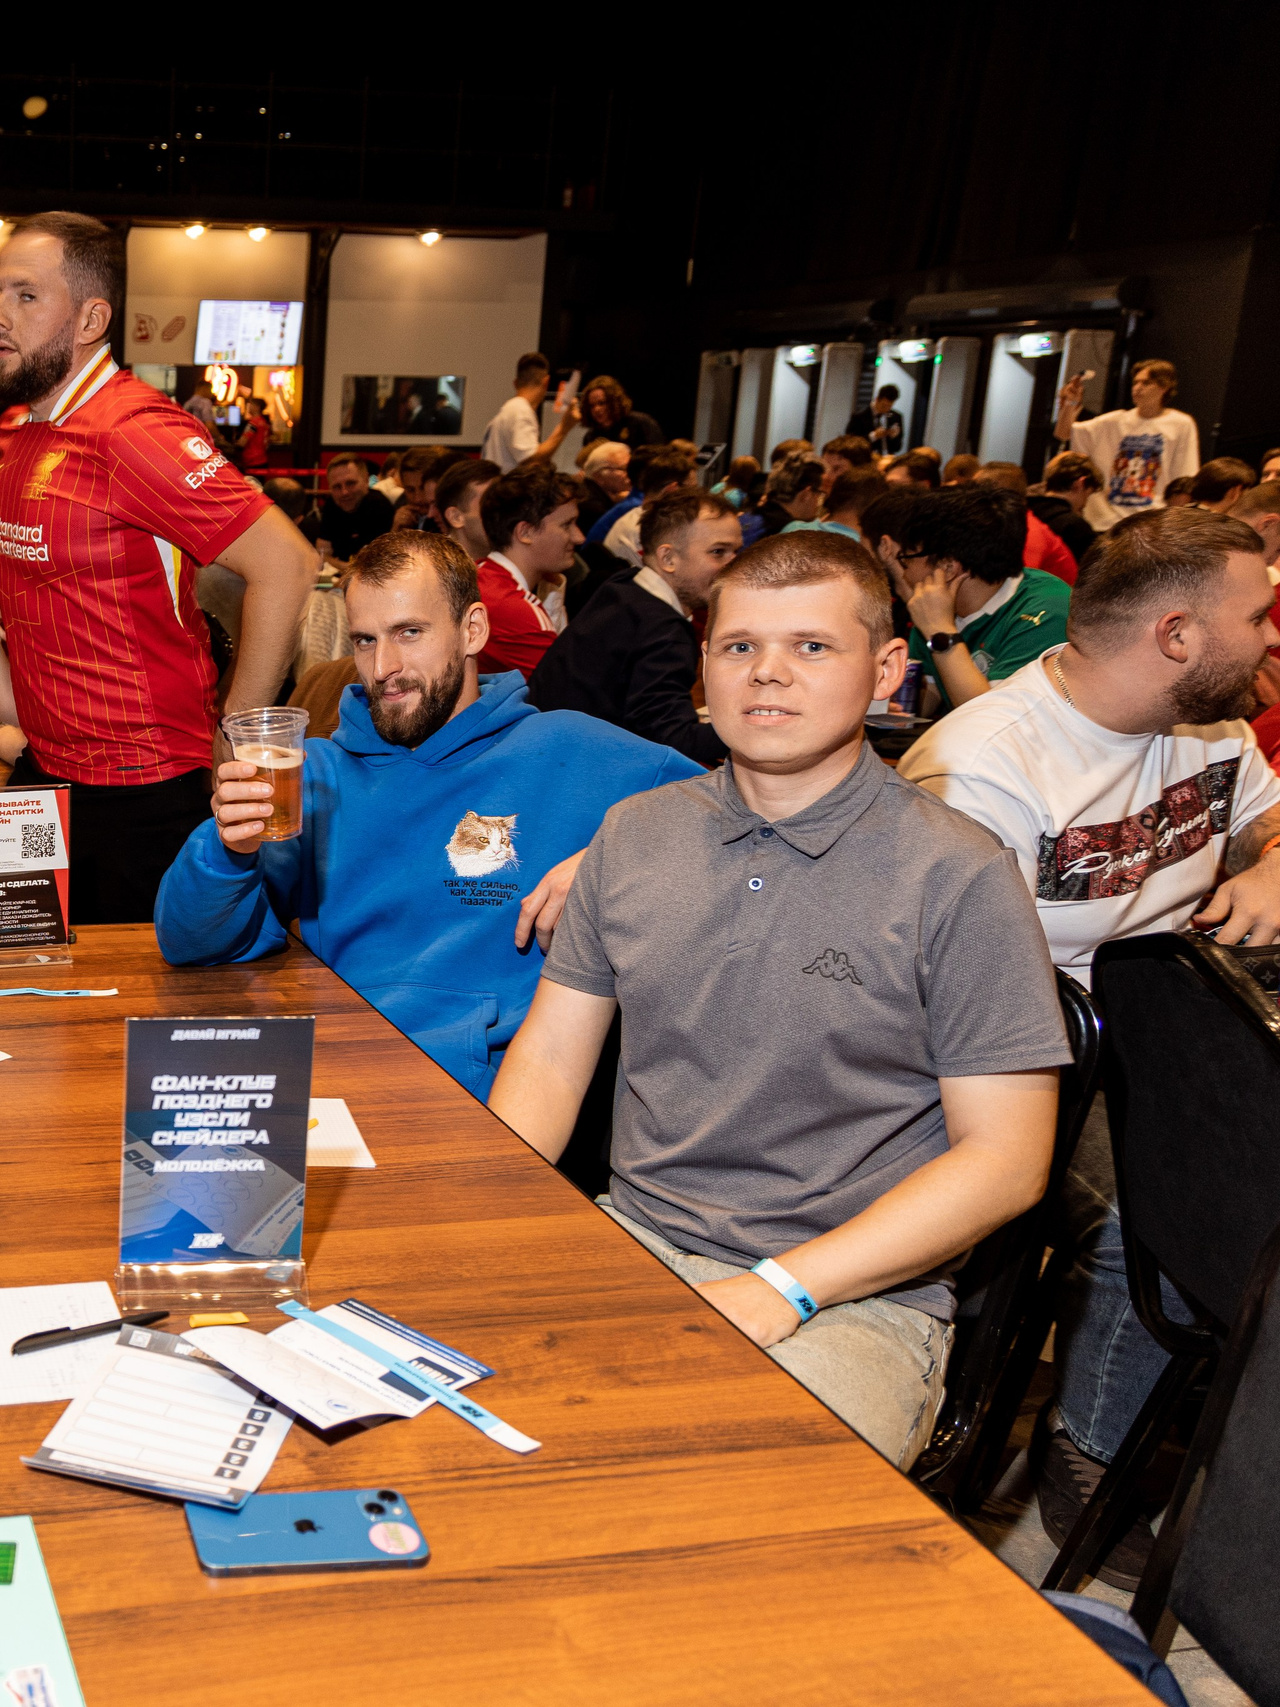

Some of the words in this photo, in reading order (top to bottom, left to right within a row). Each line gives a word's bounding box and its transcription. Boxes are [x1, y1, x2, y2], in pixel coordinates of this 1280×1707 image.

[7, 879, 49, 888] СДЕЛАТЬ
[444, 880, 459, 888] так
[481, 881, 521, 892] сильно,
[450, 888, 466, 896] как
[171, 1029, 216, 1042] ДАВАЙ
[216, 1028, 260, 1040] ИГРАЙ!
[151, 1075, 276, 1092] ФАН-КЛУБ
[152, 1093, 273, 1110] ПОЗДНЕГО
[151, 1128, 270, 1146] СНЕЙДЕРА
[153, 1158, 266, 1173] МОЛОДЁЖКА
[237, 1440, 250, 1449] 3
[229, 1454, 242, 1465] 2
